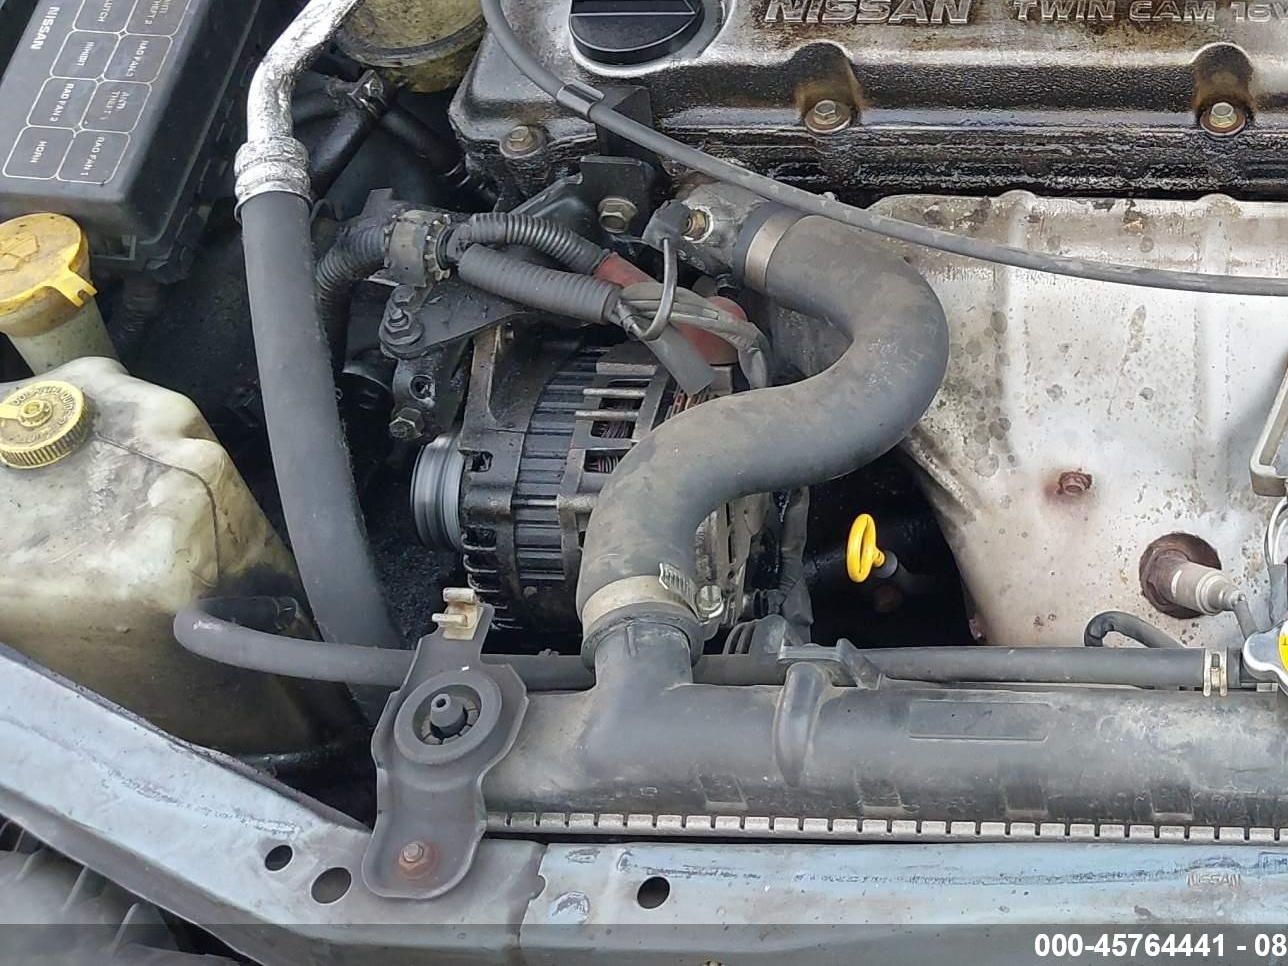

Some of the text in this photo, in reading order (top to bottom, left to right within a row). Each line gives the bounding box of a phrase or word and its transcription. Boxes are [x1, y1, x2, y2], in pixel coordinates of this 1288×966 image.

[1012, 0, 1116, 22] TWIN
[1129, 1, 1215, 22] CAM
[30, 6, 60, 50] NISSAN
[29, 140, 47, 163] HORN
[1186, 872, 1241, 887] NISSAN
